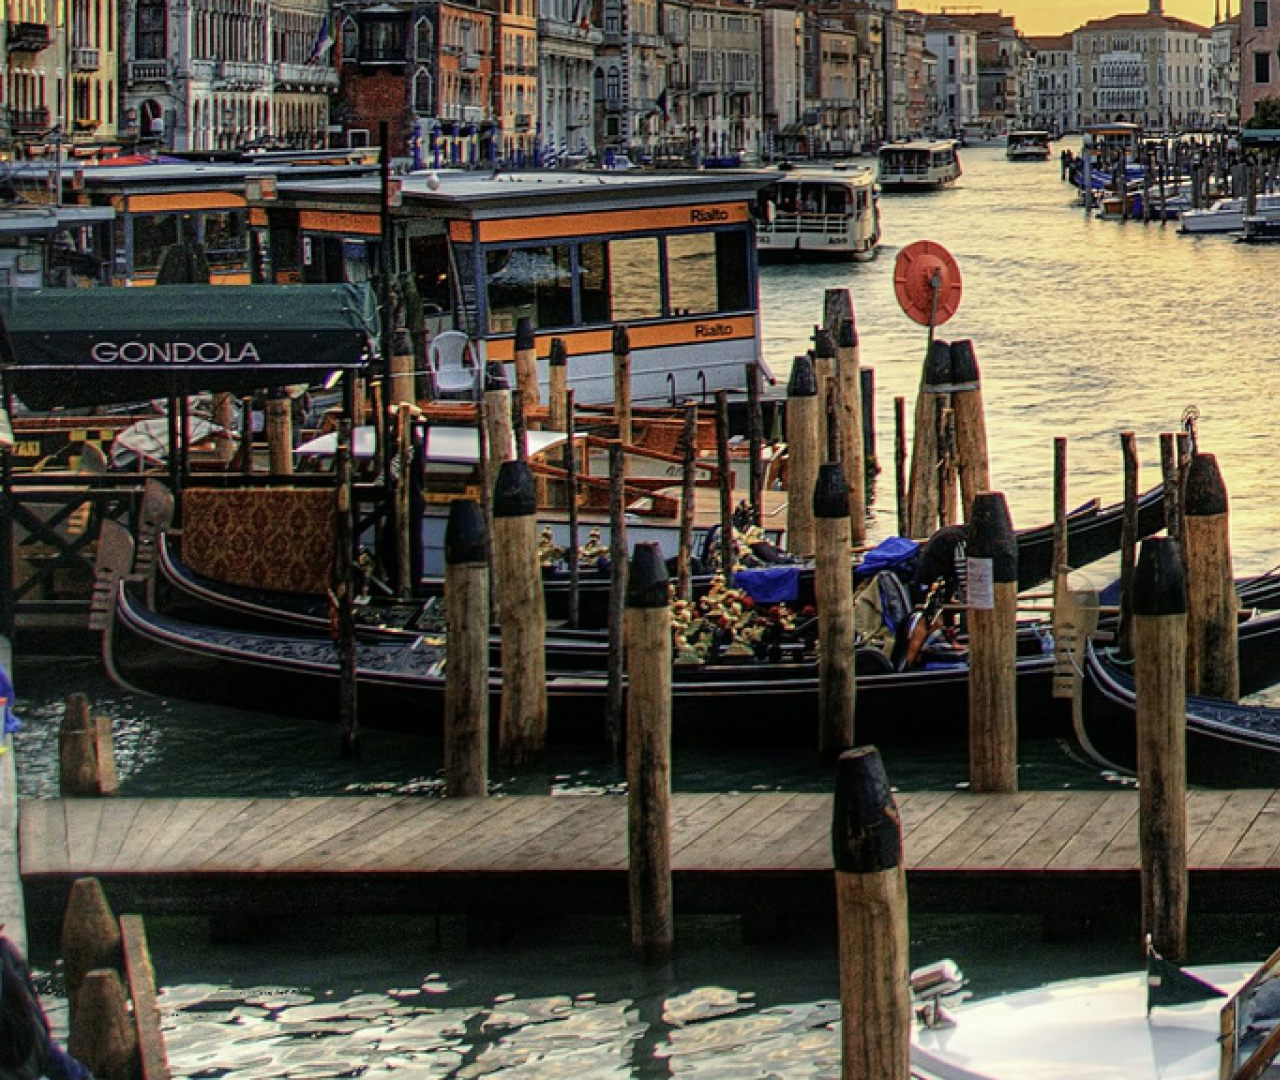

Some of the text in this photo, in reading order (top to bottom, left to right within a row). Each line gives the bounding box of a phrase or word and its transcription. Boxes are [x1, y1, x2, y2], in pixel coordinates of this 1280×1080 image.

[690, 208, 729, 222] Rialto
[695, 324, 733, 338] Rialto
[91, 341, 261, 363] GONDOLA
